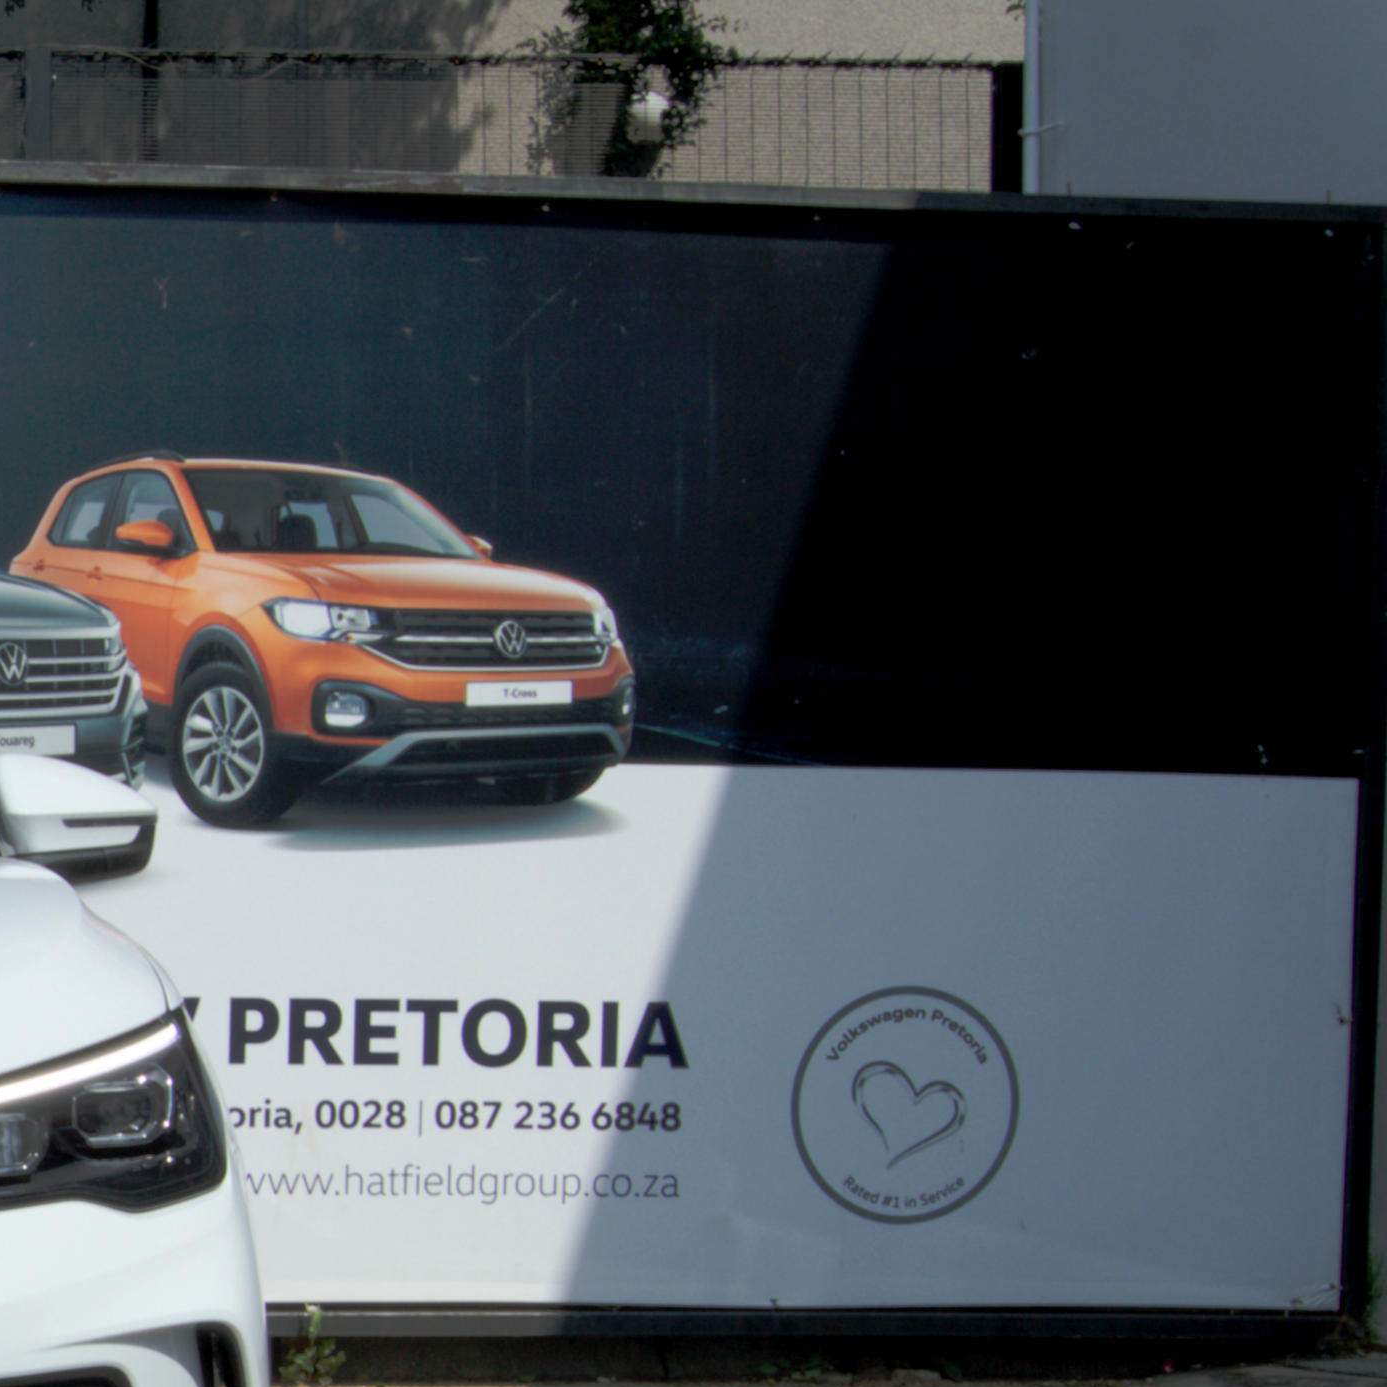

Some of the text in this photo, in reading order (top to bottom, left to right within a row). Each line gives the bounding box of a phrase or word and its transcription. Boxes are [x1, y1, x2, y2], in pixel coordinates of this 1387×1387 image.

[503, 688, 537, 699] T-Cross
[228, 996, 689, 1070] PRETORIA
[826, 1008, 989, 1065] Volkswagen Pretoria
[314, 1099, 407, 1130] 0028
[434, 1100, 502, 1130] 087
[514, 1100, 581, 1131] 236
[591, 1102, 681, 1132] 6848
[843, 1175, 965, 1209] Rated #1 in Service
